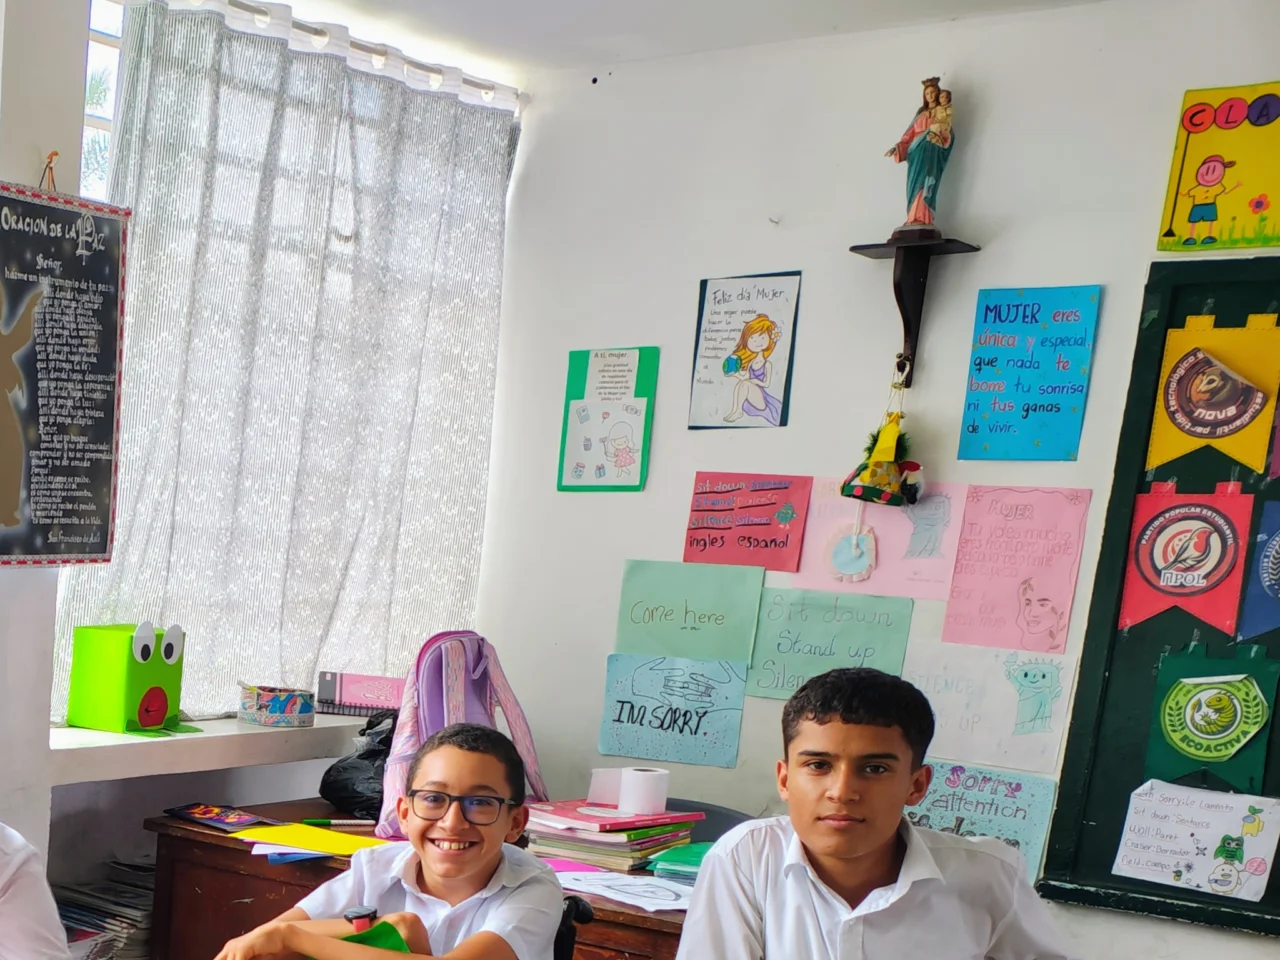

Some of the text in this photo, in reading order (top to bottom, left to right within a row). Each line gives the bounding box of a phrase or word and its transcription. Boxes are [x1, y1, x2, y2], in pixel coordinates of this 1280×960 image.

[49, 223, 62, 237] DE
[65, 224, 77, 239] LA
[80, 279, 87, 290] de
[712, 289, 733, 306] Feliz
[983, 302, 1081, 324] MUJER eres
[978, 328, 1017, 347] única
[1026, 336, 1035, 353] y
[973, 351, 1070, 373] que nada te
[969, 375, 1084, 395] borre tu sonrisa
[967, 396, 1061, 419] ni tus ganas
[967, 418, 1017, 433] de vivir.
[1141, 515, 1165, 545] PARTIDO
[1165, 507, 1201, 519] POPULAR
[1202, 509, 1235, 545] ESTUDIANTIL
[689, 533, 790, 552] ingles español
[630, 599, 725, 625] Come here
[767, 594, 893, 627] Sit down
[777, 629, 875, 667] Stand up
[757, 659, 805, 688] Silen
[945, 765, 1022, 799] Sorry
[932, 791, 1027, 821] attention
